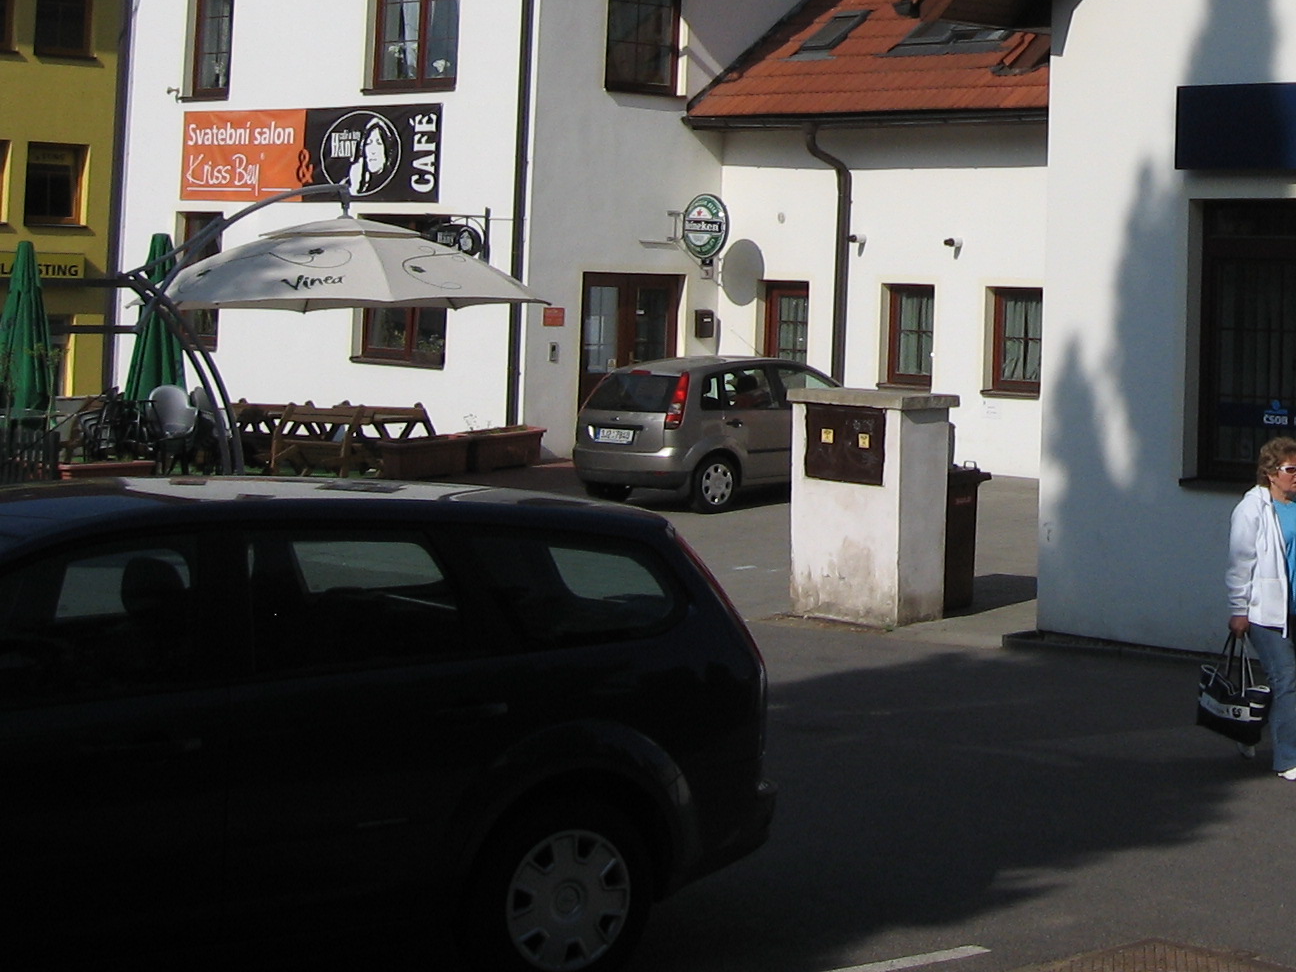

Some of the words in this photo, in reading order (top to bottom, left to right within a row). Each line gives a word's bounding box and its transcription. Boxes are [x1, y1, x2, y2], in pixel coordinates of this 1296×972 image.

[187, 121, 251, 146] Svatební
[253, 120, 295, 145] salon
[331, 132, 358, 162] Hany
[297, 148, 314, 184] &
[409, 113, 437, 193] CAFÉ
[186, 153, 232, 185] Kriss
[281, 274, 346, 290] Vinea
[1263, 414, 1288, 425] ČSOB
